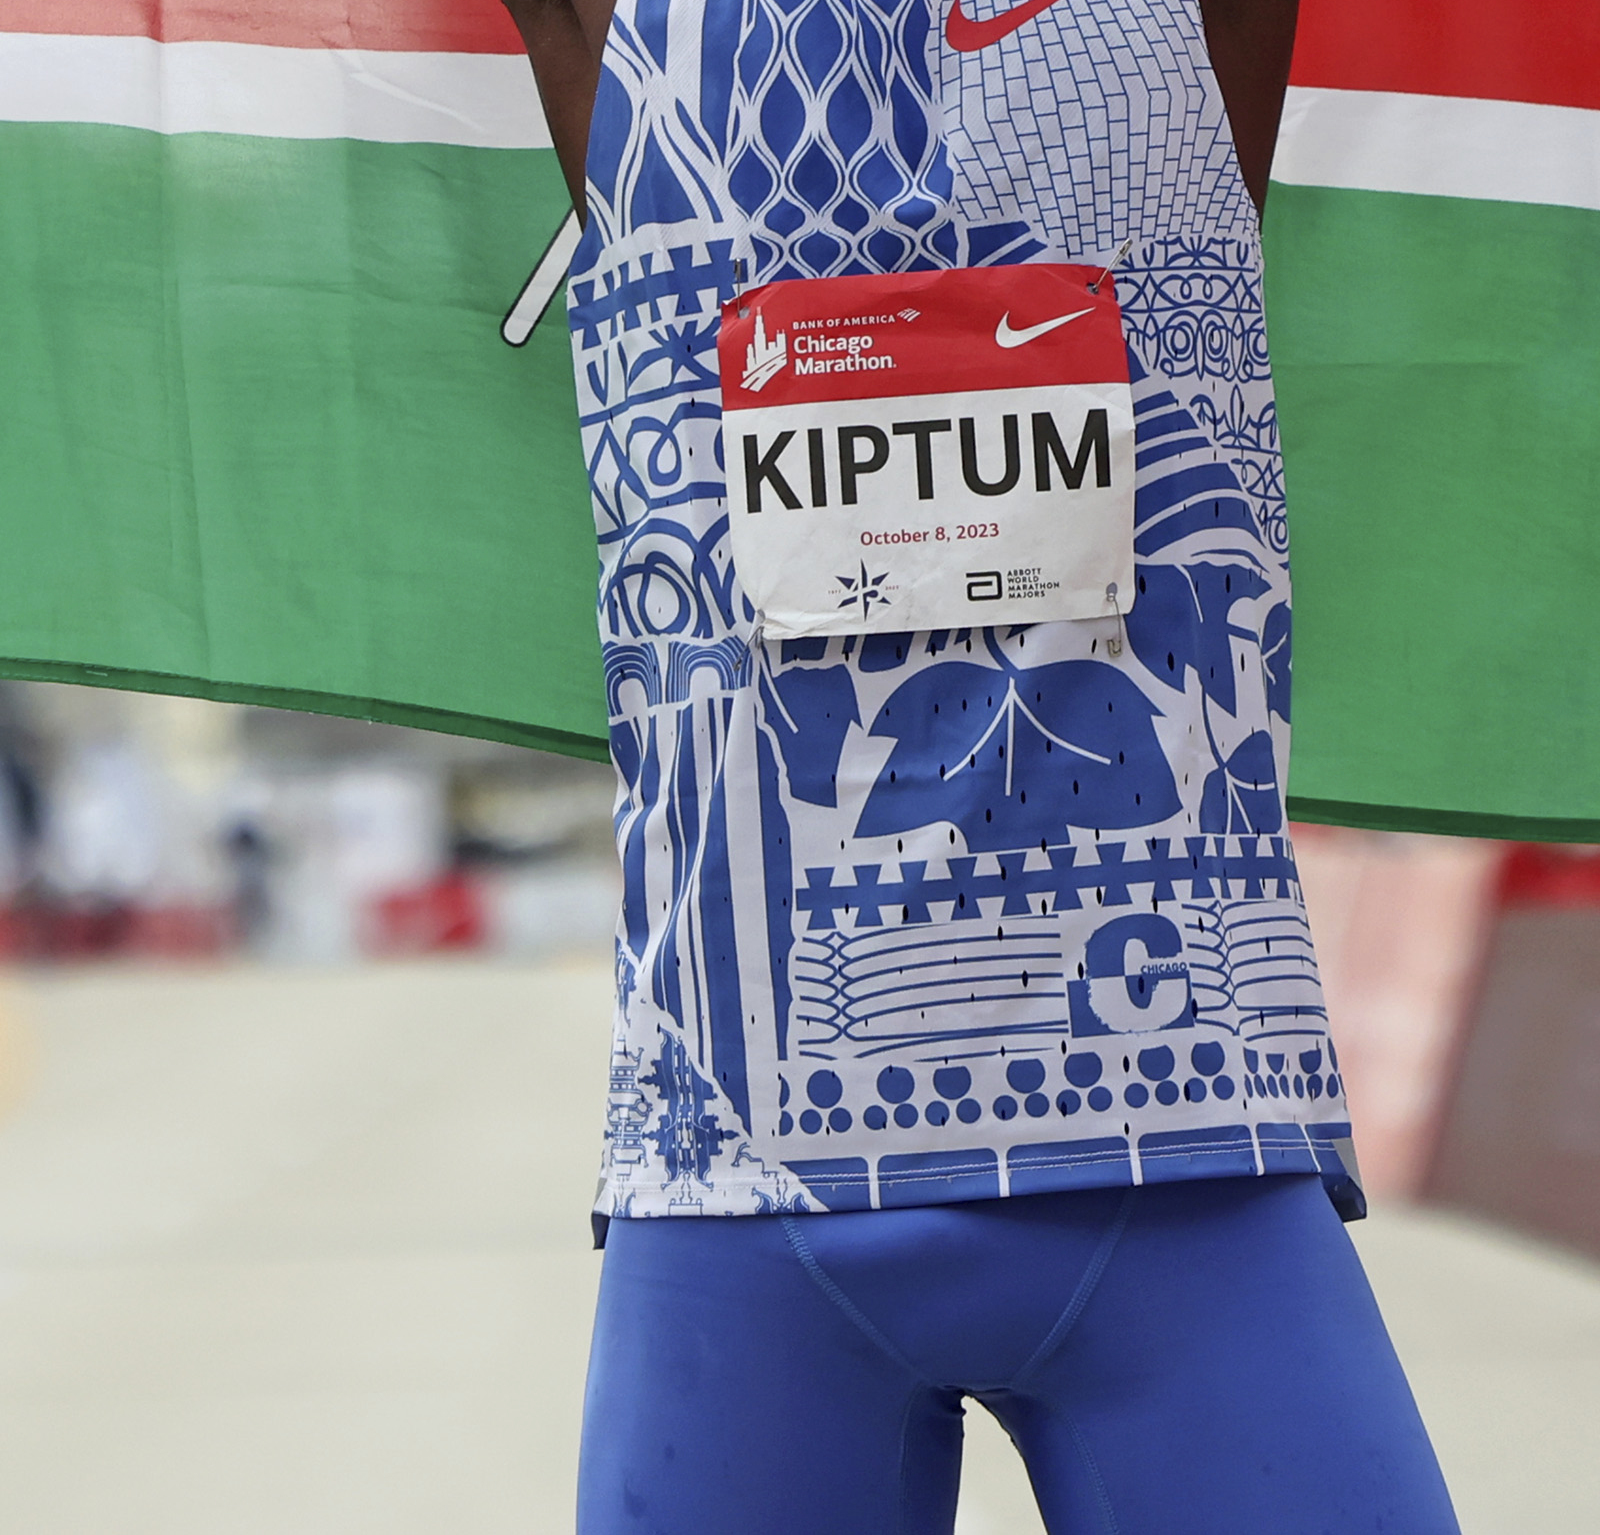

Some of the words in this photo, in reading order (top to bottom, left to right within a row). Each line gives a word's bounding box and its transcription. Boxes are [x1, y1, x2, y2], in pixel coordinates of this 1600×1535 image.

[792, 319, 824, 330] BANK
[826, 318, 841, 328] OF
[843, 314, 896, 326] AMERICA
[793, 334, 873, 354] Chicago
[742, 408, 1112, 514] KIPTUM
[860, 528, 930, 546] October
[935, 526, 950, 543] 8,
[956, 523, 1000, 540] 2023
[1007, 567, 1042, 577] ABBOTT
[1007, 575, 1039, 584] WORLD
[1008, 581, 1060, 592] MARATHON
[1008, 590, 1046, 599] MAJORS
[1140, 961, 1188, 975] CHICAGO
